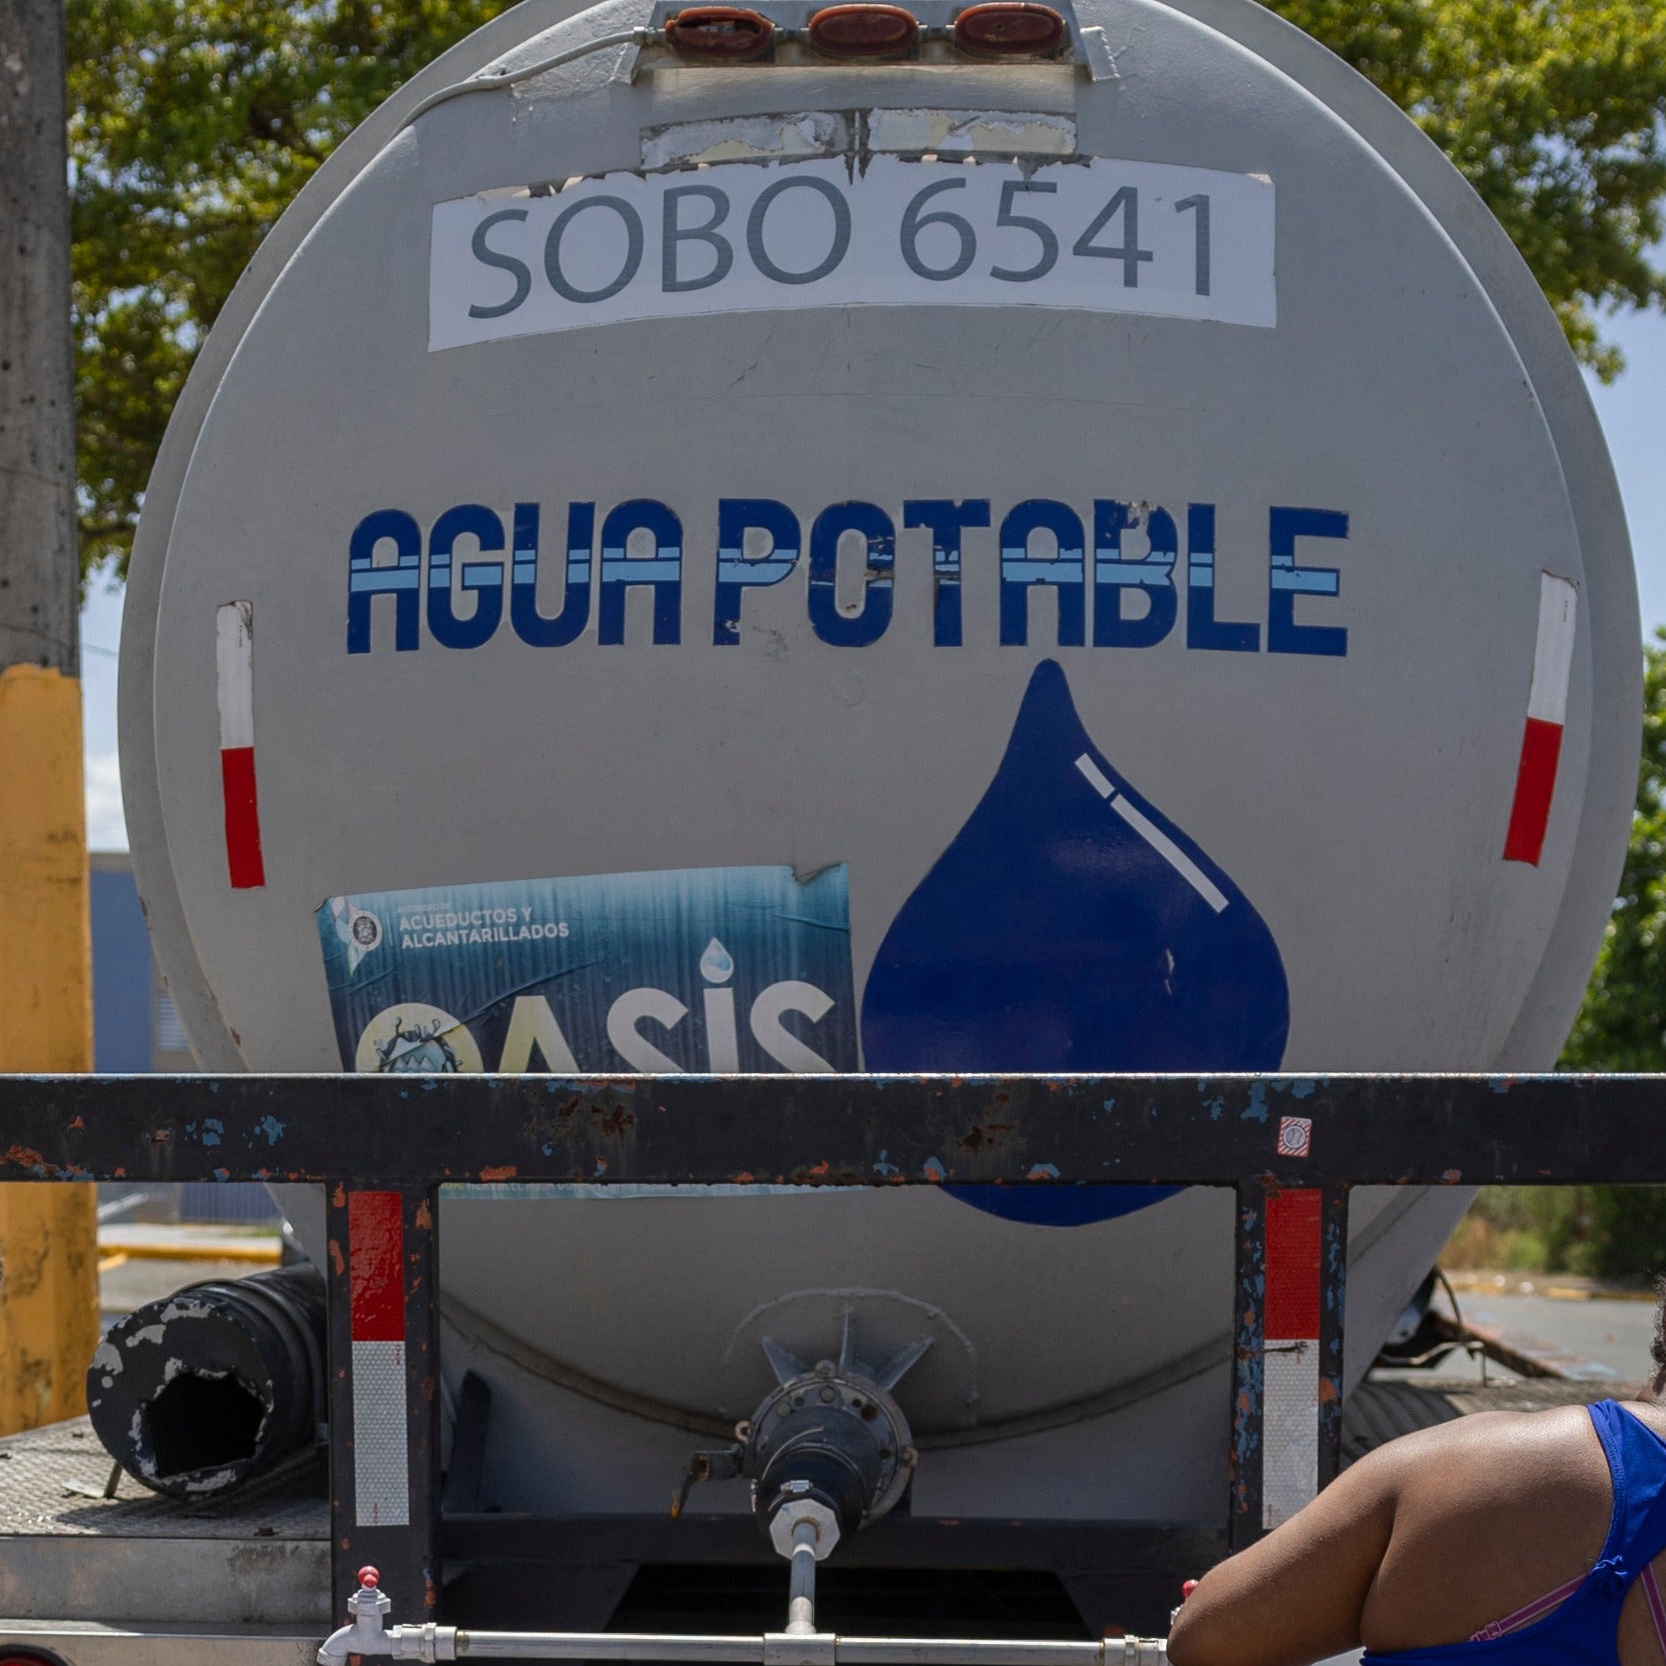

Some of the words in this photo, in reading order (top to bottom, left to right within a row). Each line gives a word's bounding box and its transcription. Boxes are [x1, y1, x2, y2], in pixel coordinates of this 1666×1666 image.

[467, 174, 854, 319] SOBO
[898, 175, 1213, 297] 6541
[346, 498, 684, 654] AGUA
[712, 498, 1351, 657] POTABLE
[399, 907, 517, 932] ACUEDUCTOS
[521, 907, 533, 922] Y
[401, 922, 570, 949] ALCANTARILLADOS
